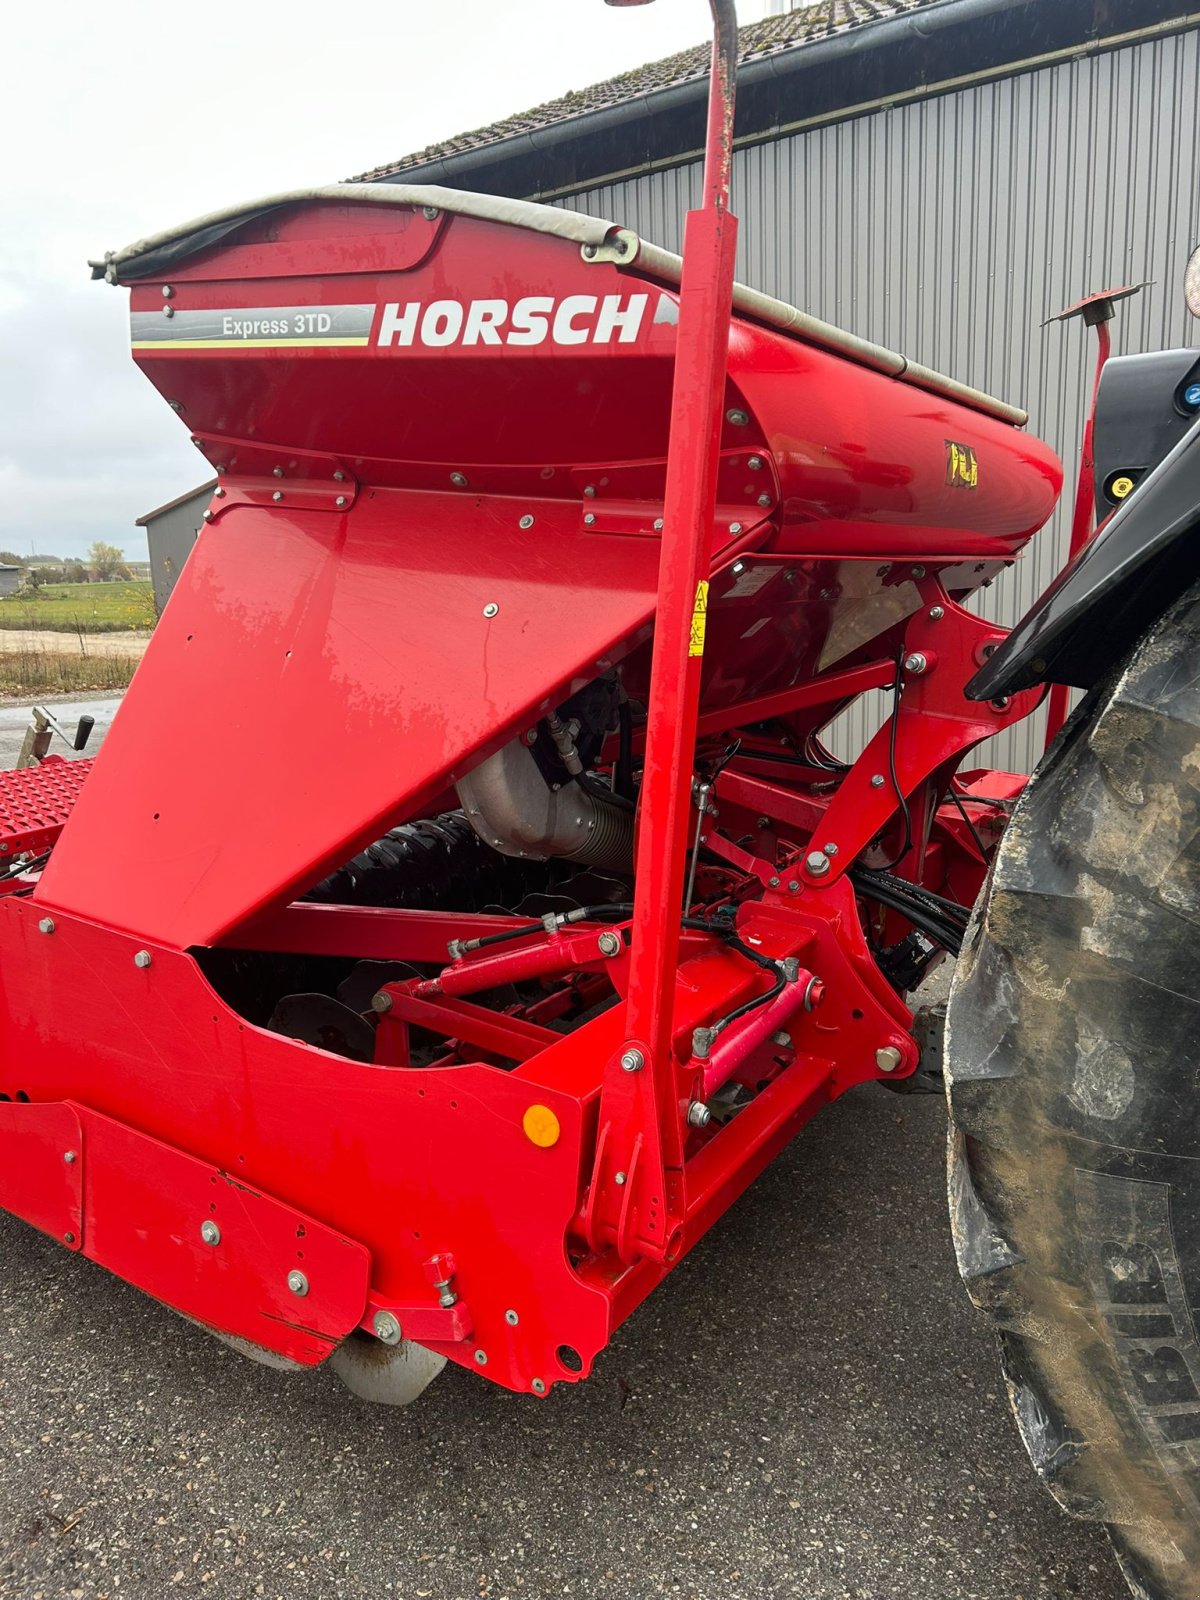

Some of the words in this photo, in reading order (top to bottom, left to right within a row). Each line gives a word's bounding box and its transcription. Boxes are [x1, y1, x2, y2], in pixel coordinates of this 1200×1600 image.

[222, 316, 289, 339] Express
[294, 313, 331, 333] 3TD
[377, 293, 649, 347] HORSCH
